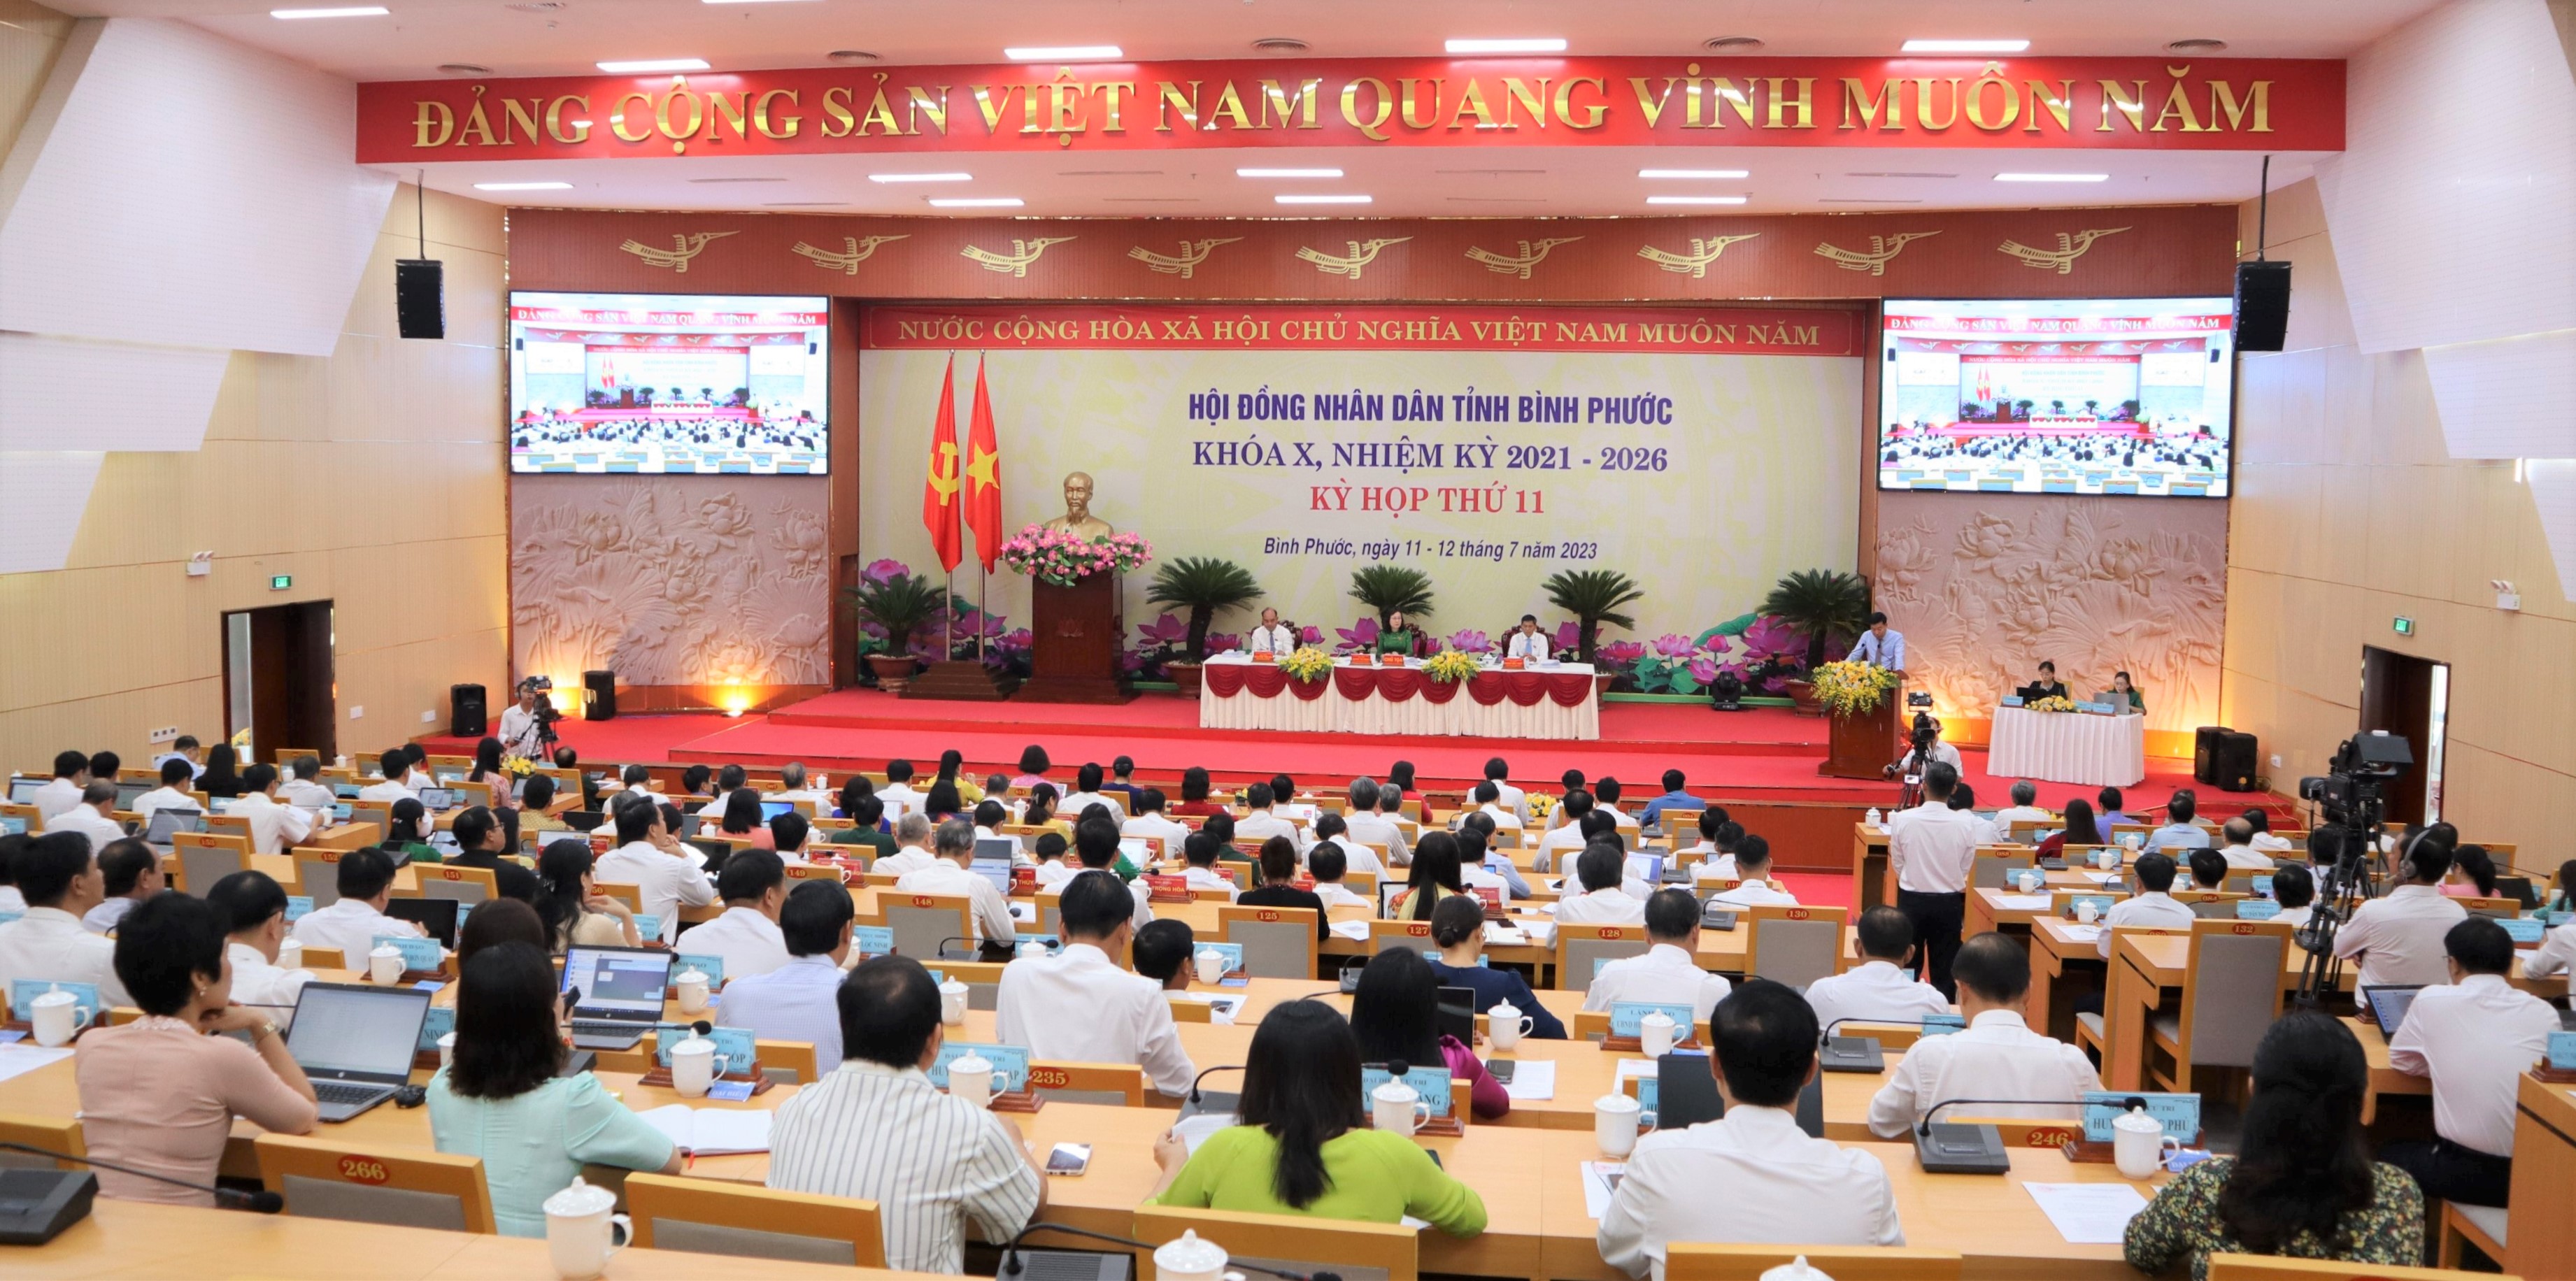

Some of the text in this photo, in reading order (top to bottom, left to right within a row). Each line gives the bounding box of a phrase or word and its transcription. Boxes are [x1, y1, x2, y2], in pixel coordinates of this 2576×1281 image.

[413, 86, 590, 148] ĐẢNG
[611, 76, 800, 154] CỘNG
[821, 72, 951, 138] SẢN
[971, 67, 1137, 146] VIỆT
[1159, 78, 1323, 131] NAM
[1340, 77, 1609, 141] QUANG
[1837, 64, 2073, 132] MUÔN
[2096, 65, 2275, 133] NĂM
[899, 313, 1819, 347] NƯỚC CỘNG HÒA XÃ HỘI CHỦ NGHĨA VIỆT NAM MUÔN NĂM
[1190, 385, 1672, 425] HỘI ĐỒNG NHÂN DÂN TỈNH BÌNH PHƯỚC
[1193, 434, 1286, 466] KHÓA
[1293, 442, 1323, 471] X,
[1332, 436, 1444, 473] NHIỆM
[1455, 436, 1498, 468] KỲ
[1507, 445, 1571, 469] 2021
[1600, 448, 1667, 471] 2026
[1310, 478, 1544, 518] KỲ HỌP THỨ 11
[1264, 537, 1300, 554] Bình
[1304, 538, 1357, 557] Phước,
[1362, 539, 1400, 561] ngày
[1405, 540, 1421, 556] 11
[1439, 540, 1455, 557] 12
[1460, 541, 1504, 561] tháng
[1510, 541, 1519, 557] 7
[1522, 542, 1556, 558] năm
[1560, 542, 1597, 559] 2023
[1033, 1071, 1066, 1085] 235
[2030, 1131, 2068, 1145] 246
[343, 1159, 385, 1180] 266
